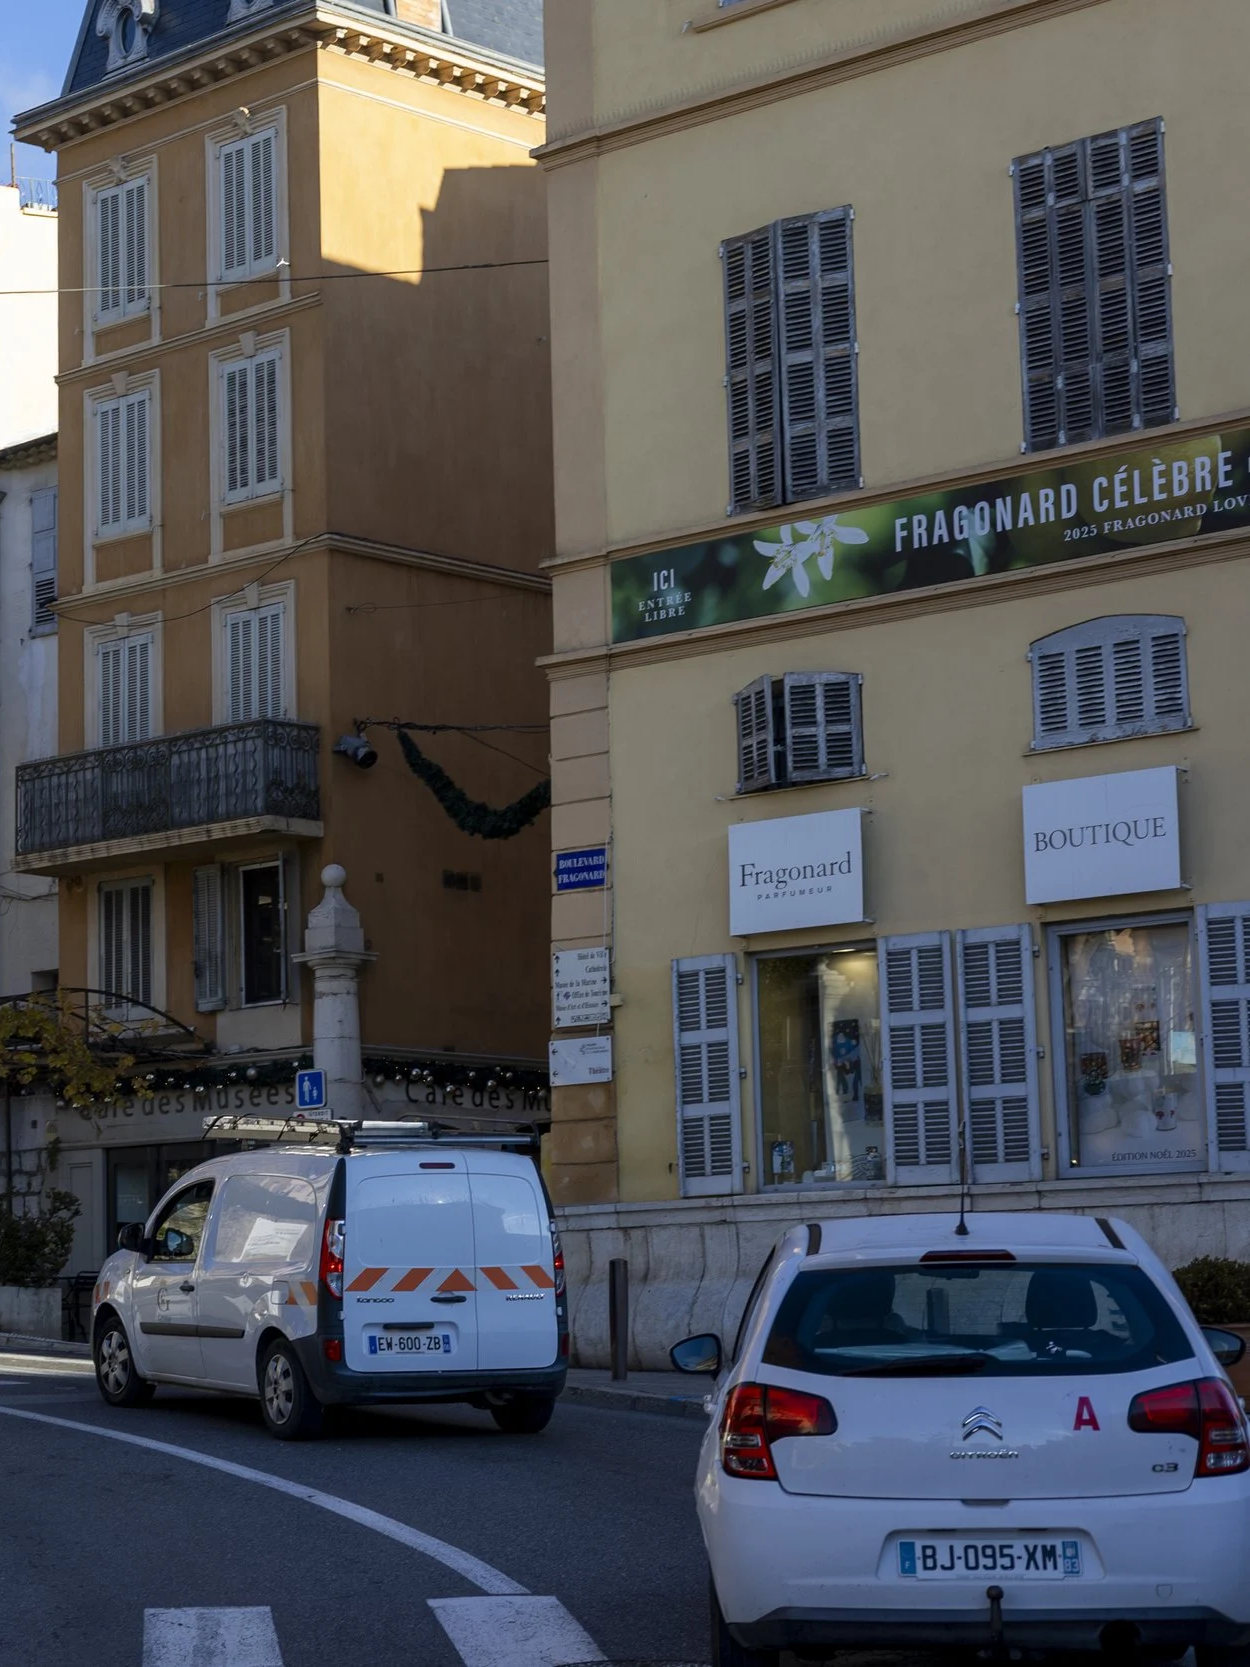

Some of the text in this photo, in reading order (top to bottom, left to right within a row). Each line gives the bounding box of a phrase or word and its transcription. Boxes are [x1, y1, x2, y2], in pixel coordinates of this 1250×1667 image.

[894, 450, 1233, 552] FRAGONARD CÉLÈBRE
[1064, 494, 1250, 541] 2025 FRAGONARD LOV
[653, 568, 675, 591] ICI
[638, 591, 692, 611] ENTRÉE
[645, 605, 686, 622] LIBRE
[1033, 816, 1167, 852] BOUTIQUE
[558, 855, 605, 869] BOULEVARD
[739, 850, 852, 890] Fragonard
[757, 885, 832, 901] PARFUMEUR
[1150, 1148, 1174, 1159] NOËL
[1175, 1149, 1197, 1159] 2025
[1073, 1396, 1101, 1431] A
[921, 1544, 1058, 1571] BJ-095-XM
